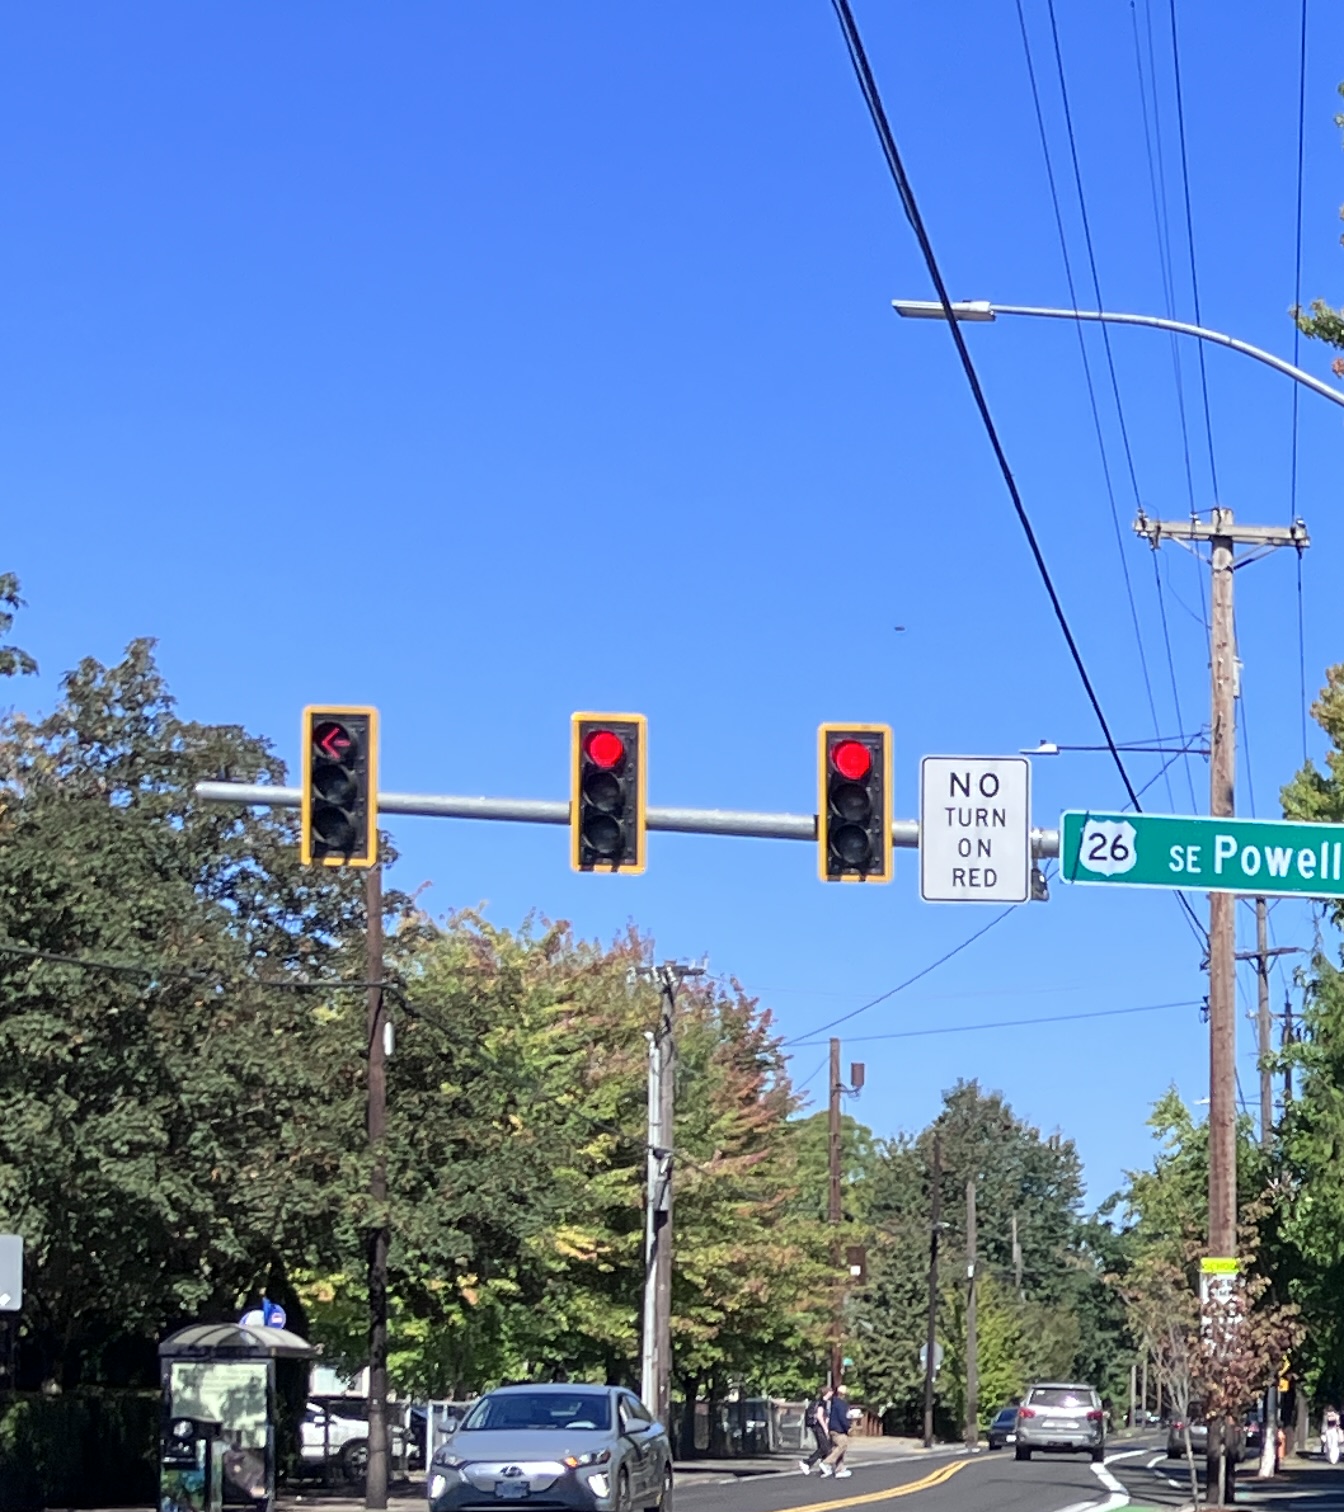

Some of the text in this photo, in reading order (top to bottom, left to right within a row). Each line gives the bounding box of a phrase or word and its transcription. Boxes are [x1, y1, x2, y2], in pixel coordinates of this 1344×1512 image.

[949, 772, 1000, 798] NO
[944, 807, 1006, 828] TURN
[958, 838, 991, 858] ON
[1088, 832, 1129, 862] 26
[1168, 845, 1202, 874] SE
[1214, 834, 1342, 881] Powell
[952, 868, 997, 888] RED
